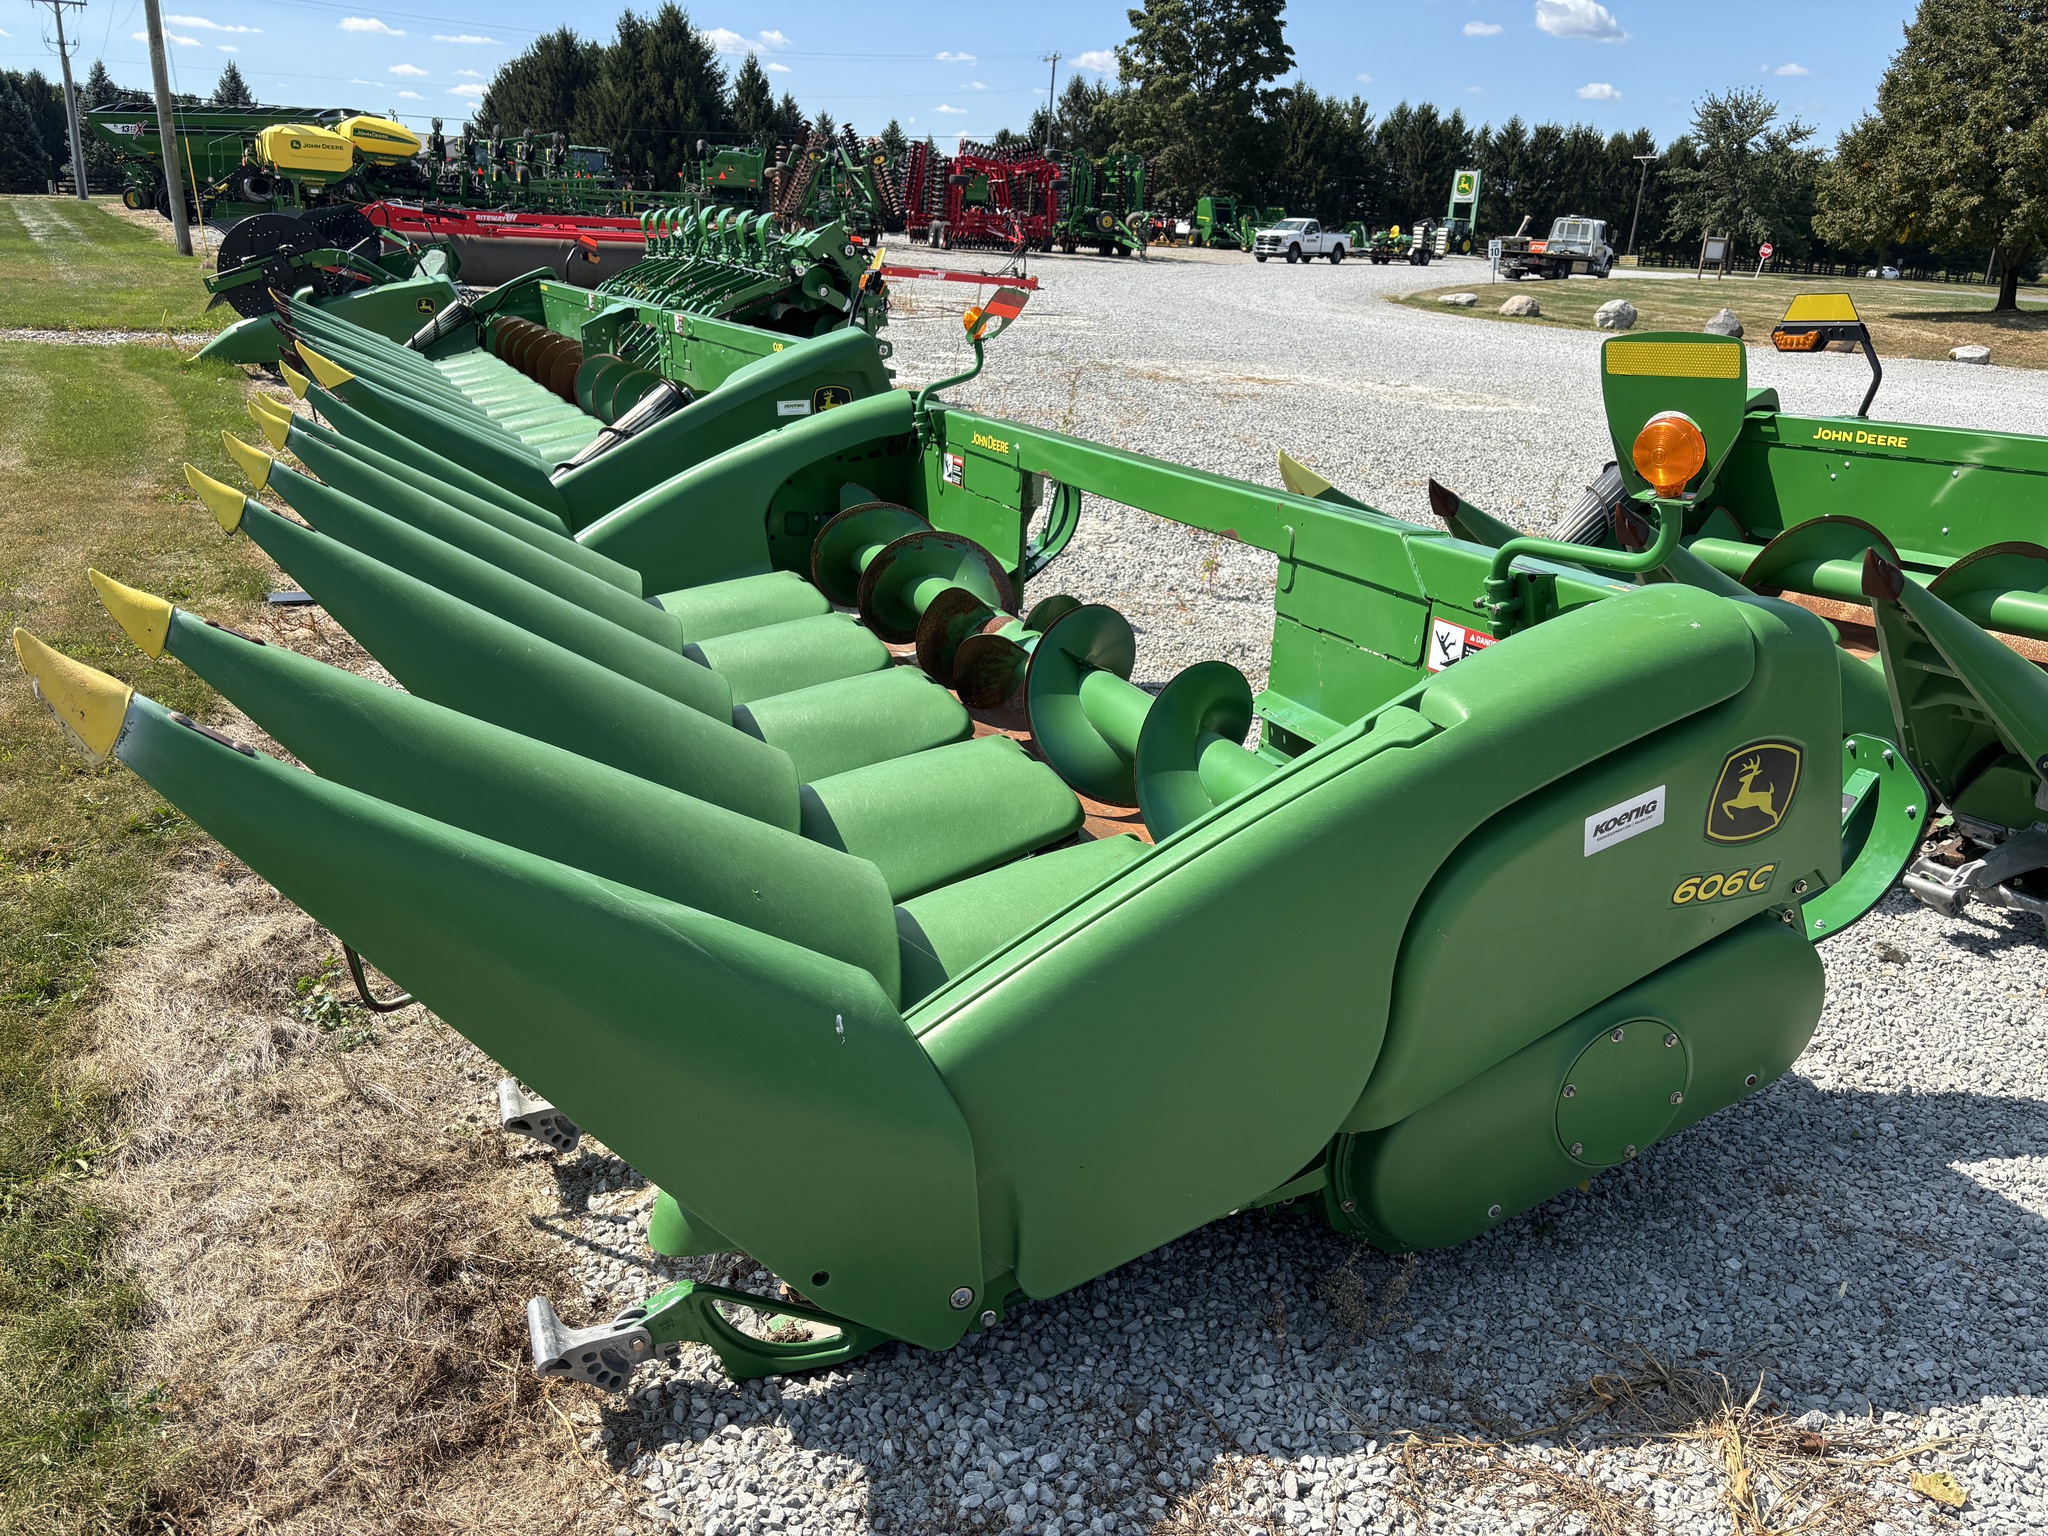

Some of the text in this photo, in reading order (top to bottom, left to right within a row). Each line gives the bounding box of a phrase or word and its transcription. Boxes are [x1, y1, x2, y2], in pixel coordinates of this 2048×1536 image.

[356, 130, 389, 139] JOHN DEERE
[322, 143, 344, 151] DEERE
[1490, 247, 1500, 257] 10
[971, 430, 1009, 454] JOHN DEERE
[1812, 426, 1909, 449] JOHN DEERE
[1475, 635, 1497, 647] DANG
[1671, 863, 1777, 906] 606C
